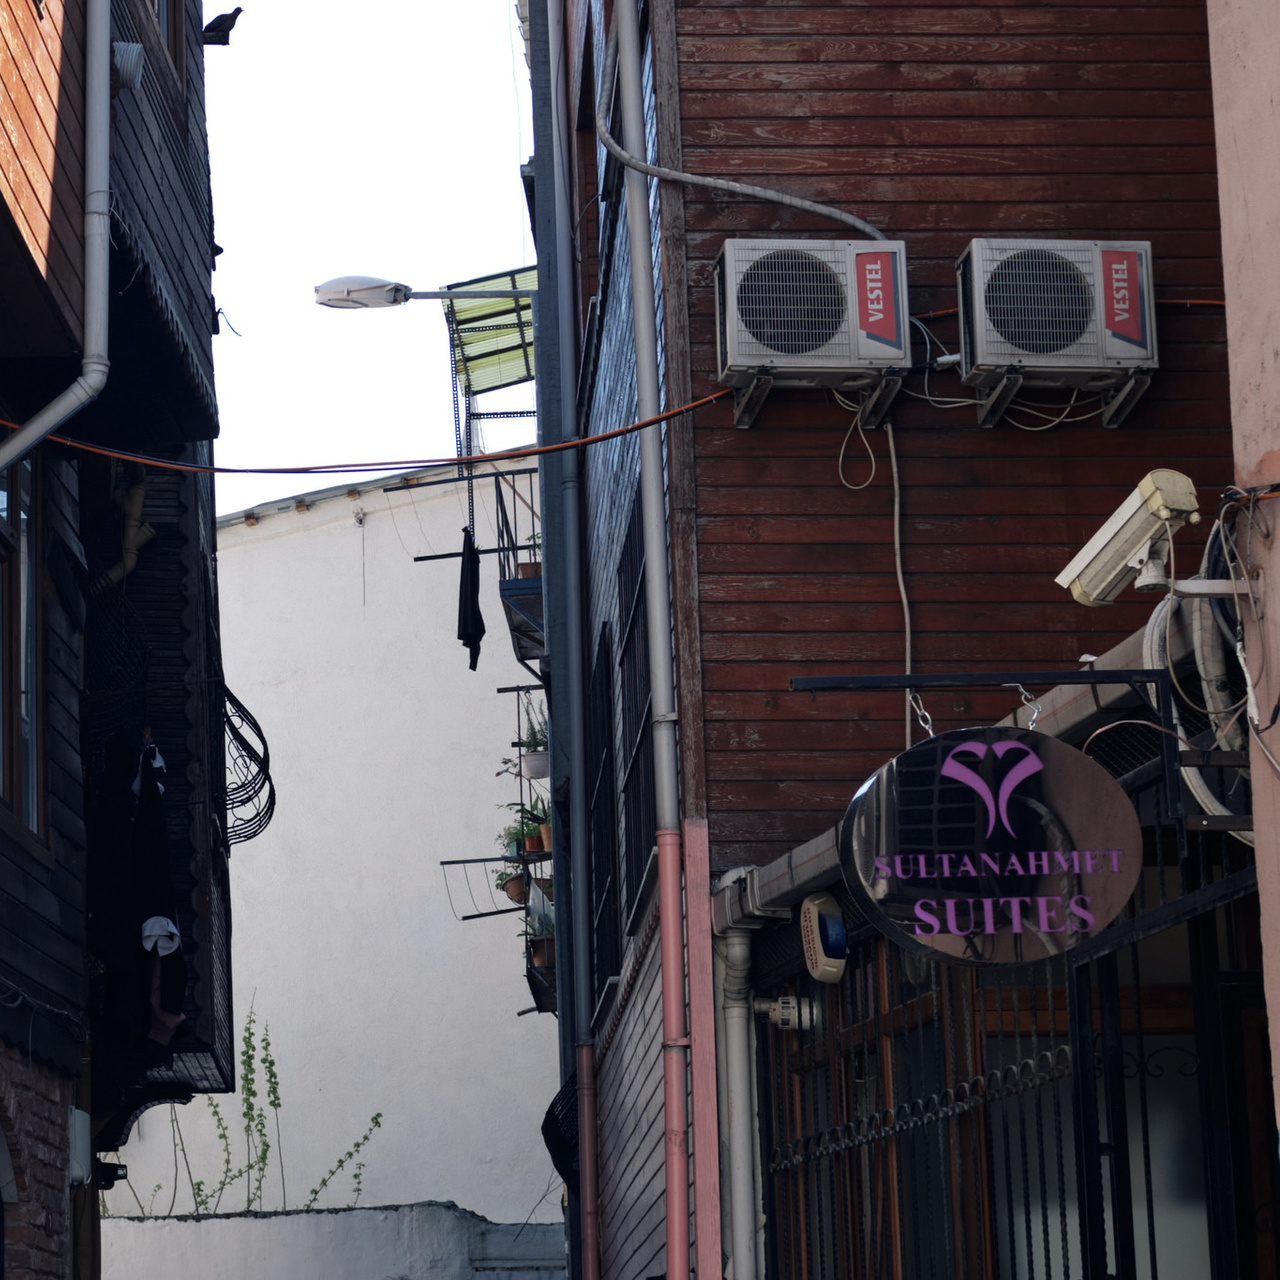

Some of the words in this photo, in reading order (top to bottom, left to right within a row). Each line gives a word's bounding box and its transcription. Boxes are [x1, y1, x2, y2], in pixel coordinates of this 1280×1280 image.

[867, 259, 884, 322] VESTEL
[1113, 259, 1130, 322] VESTEL
[874, 848, 1126, 881] SULTANAHMET
[913, 893, 1096, 937] SUITES
